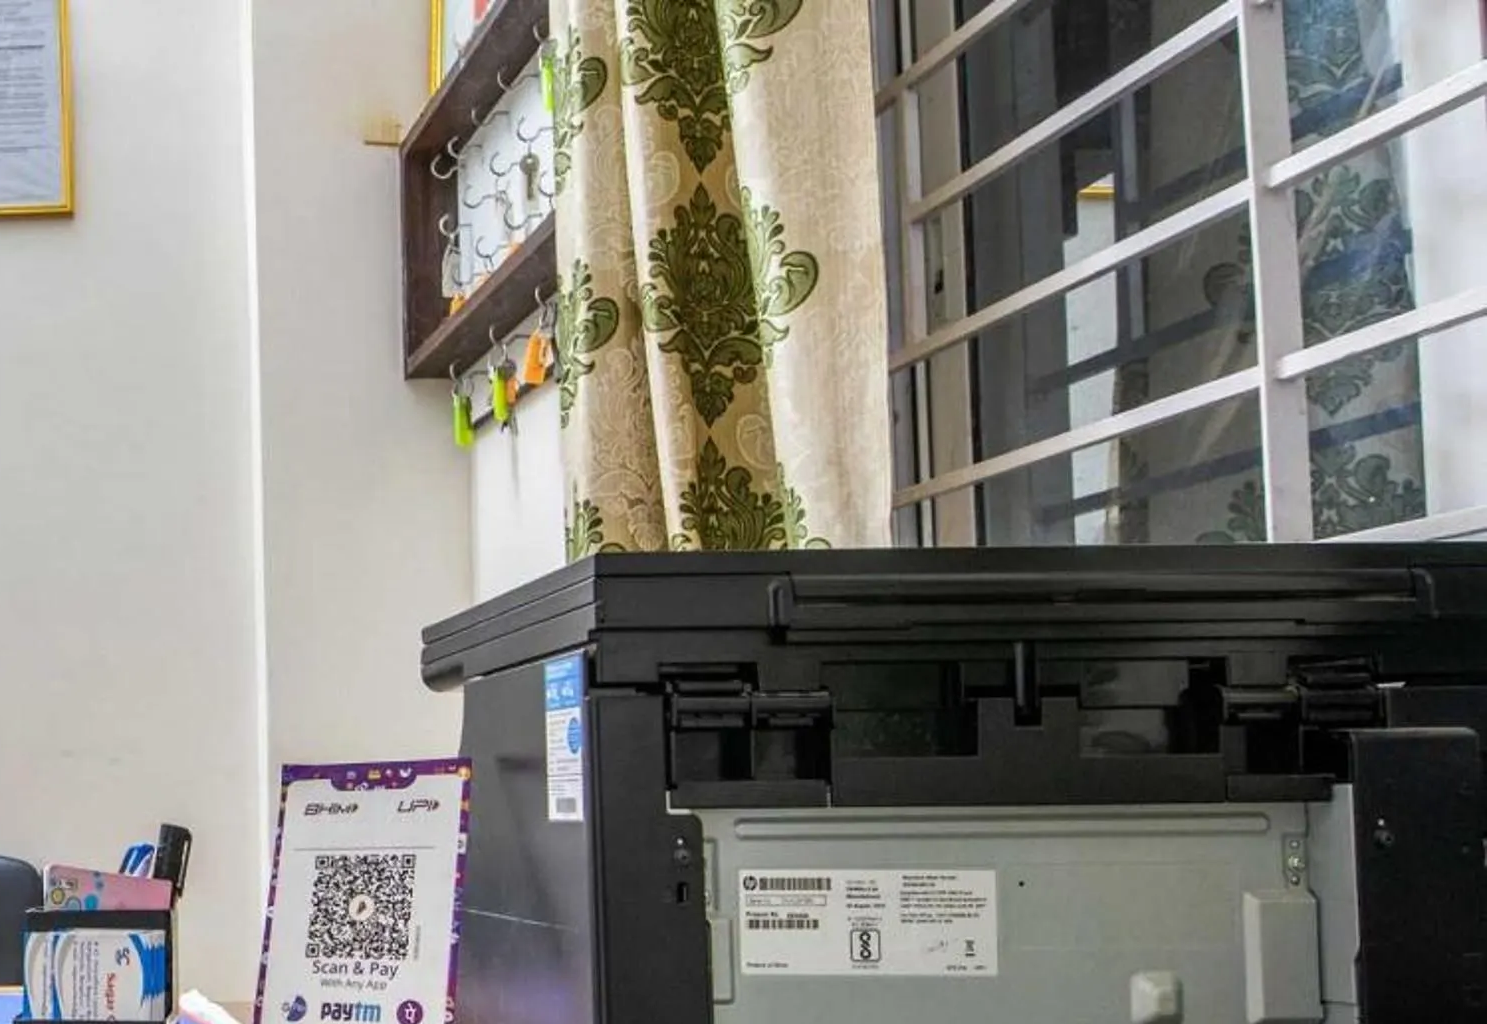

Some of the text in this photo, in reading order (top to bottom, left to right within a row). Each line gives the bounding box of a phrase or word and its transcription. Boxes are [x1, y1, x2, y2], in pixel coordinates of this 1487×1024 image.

[312, 961, 399, 980] Scan & Pay
[345, 979, 363, 991] Any
[365, 980, 388, 992] App
[320, 1001, 382, 1022] paytm
